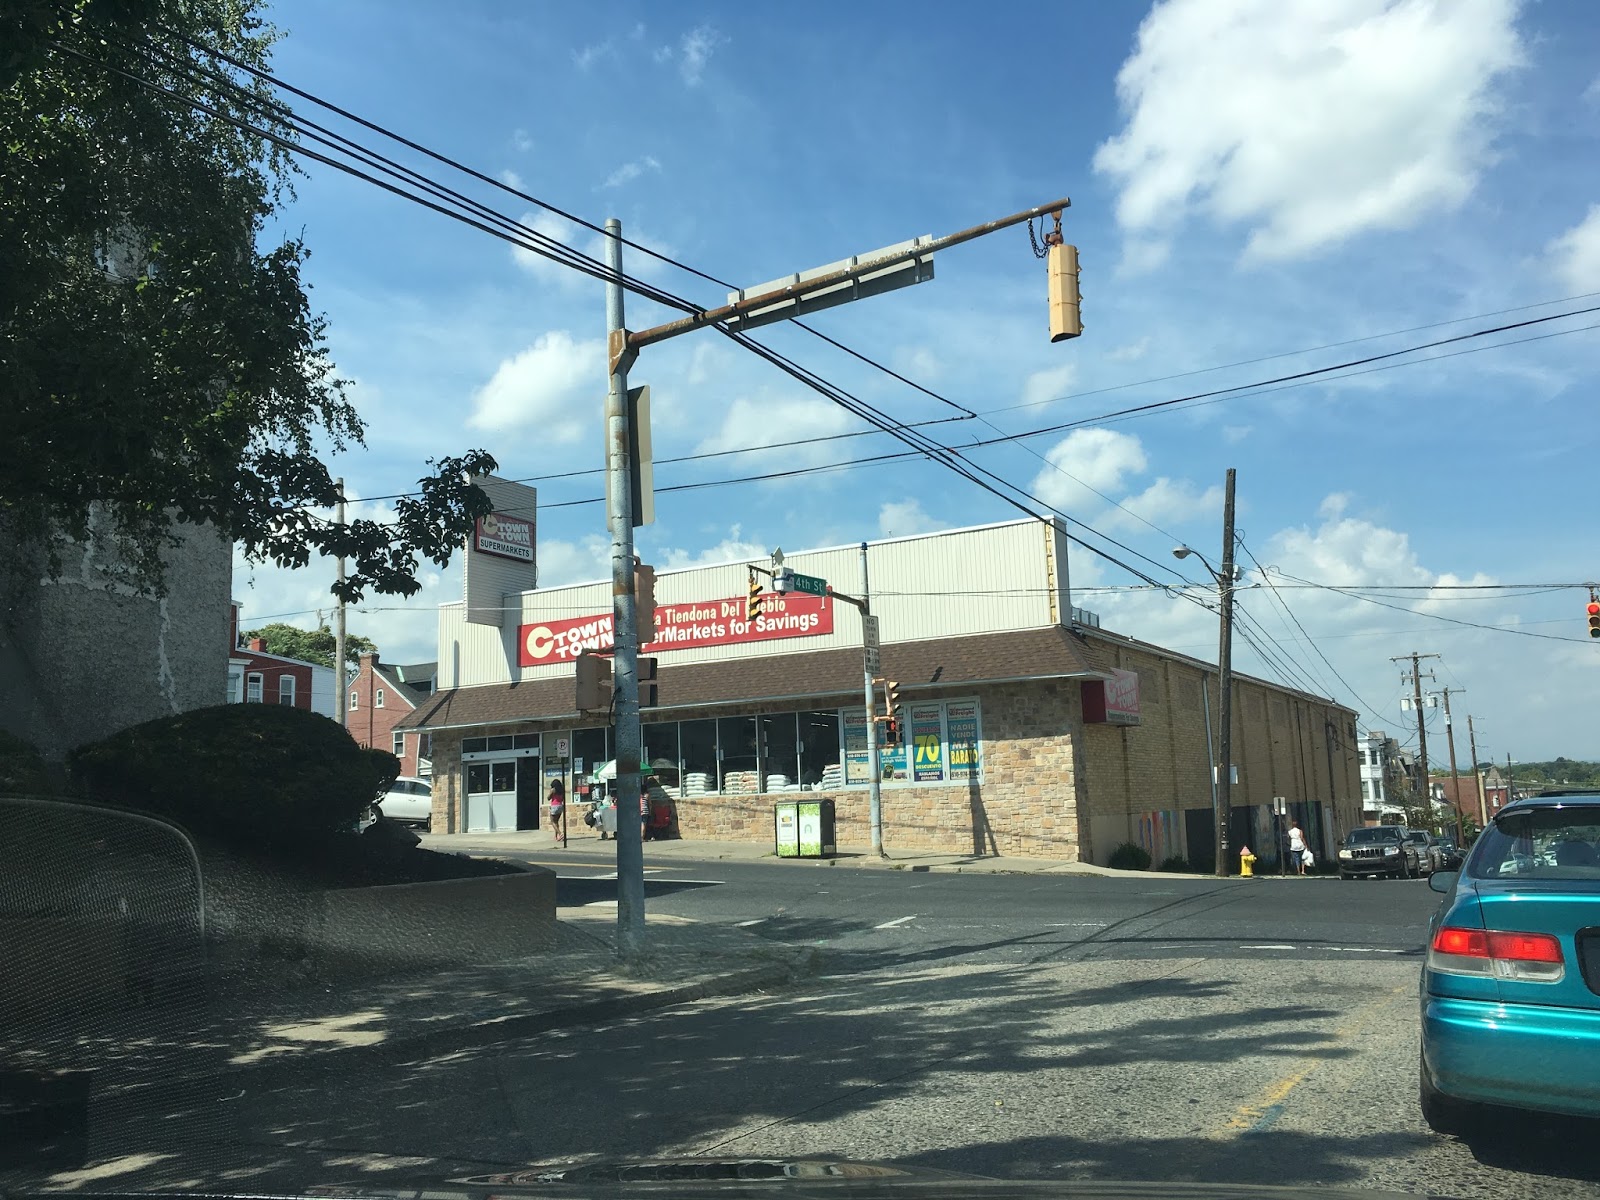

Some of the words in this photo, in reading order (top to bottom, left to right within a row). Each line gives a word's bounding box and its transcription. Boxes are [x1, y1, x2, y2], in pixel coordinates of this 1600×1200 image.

[480, 539, 530, 557] SUPERMARKETS
[795, 577, 811, 590] 4th
[813, 581, 823, 593] St
[665, 606, 717, 625] Tiendona
[721, 601, 740, 618] Del
[553, 616, 613, 647] TOWN
[642, 622, 726, 648] erMarkets
[730, 619, 752, 636] for
[755, 612, 819, 632] Savings
[950, 723, 976, 731] NADIE
[950, 749, 978, 764] BARATO
